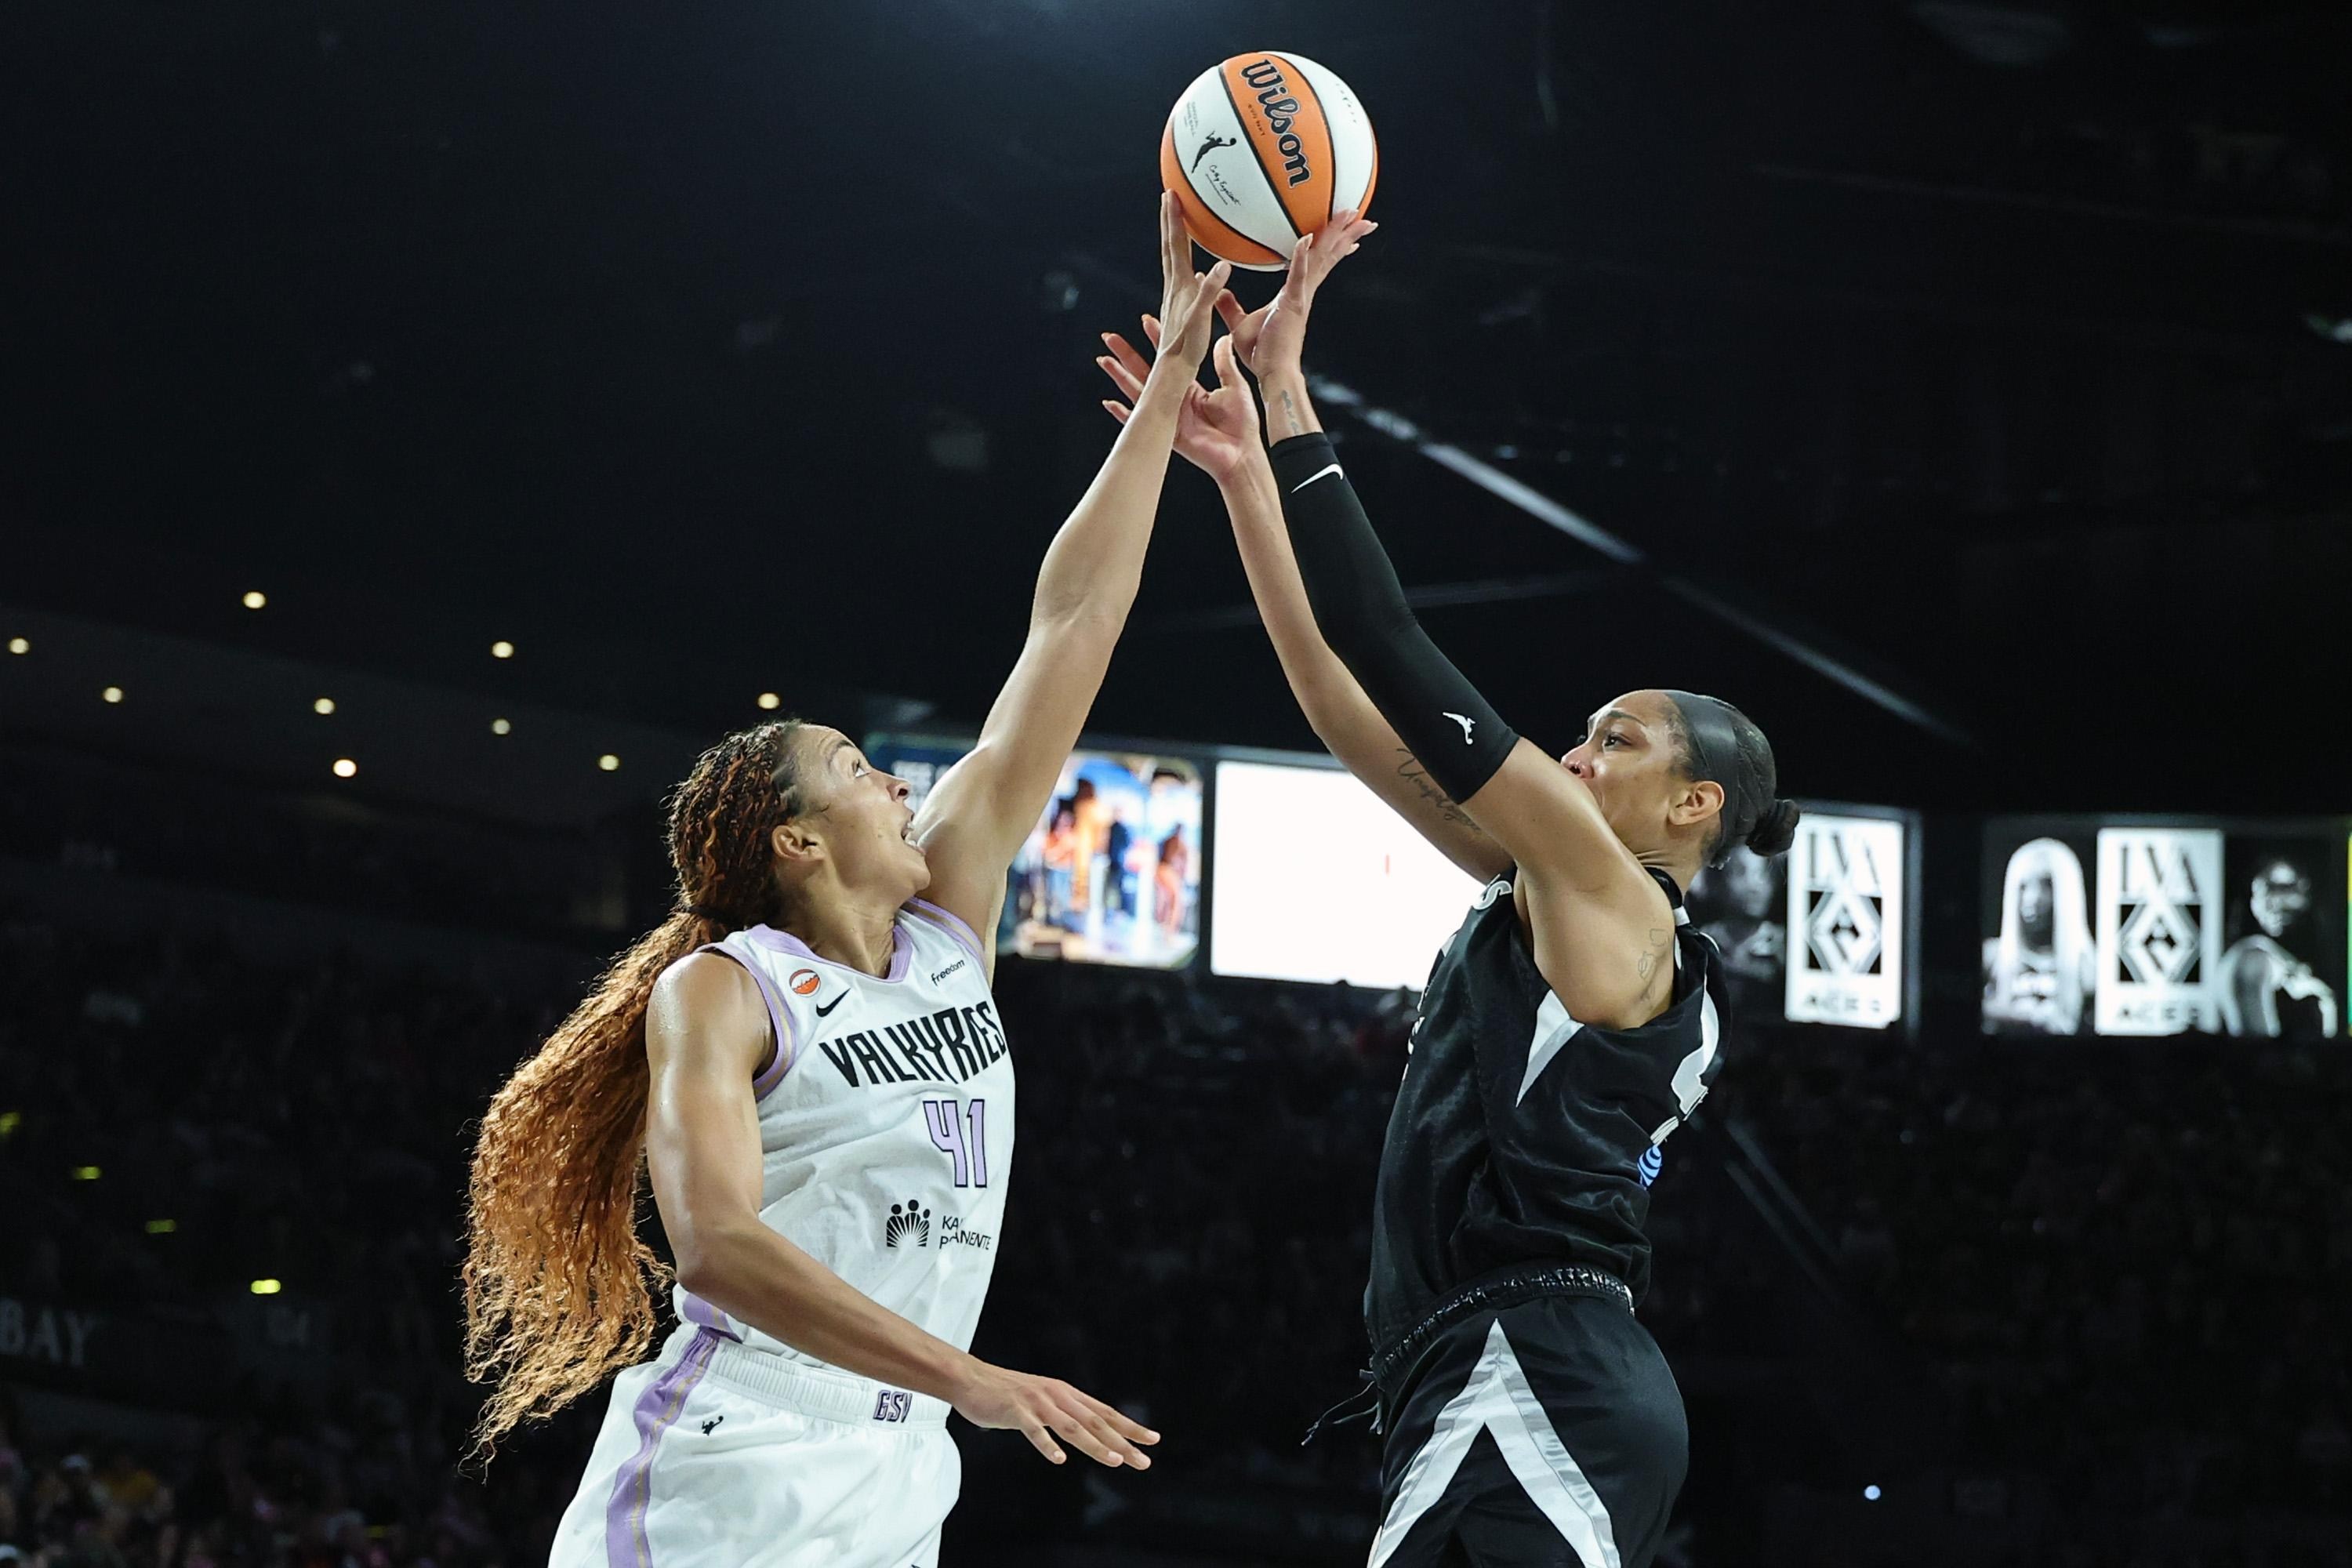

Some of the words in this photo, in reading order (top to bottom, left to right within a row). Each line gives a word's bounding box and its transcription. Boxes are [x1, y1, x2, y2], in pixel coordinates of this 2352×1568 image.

[1241, 59, 1312, 187] Wilson
[931, 960, 966, 986] freedom
[818, 1000, 1007, 1088] VALKYRIES
[922, 1098, 988, 1189] 41
[0, 1297, 100, 1369] BAY
